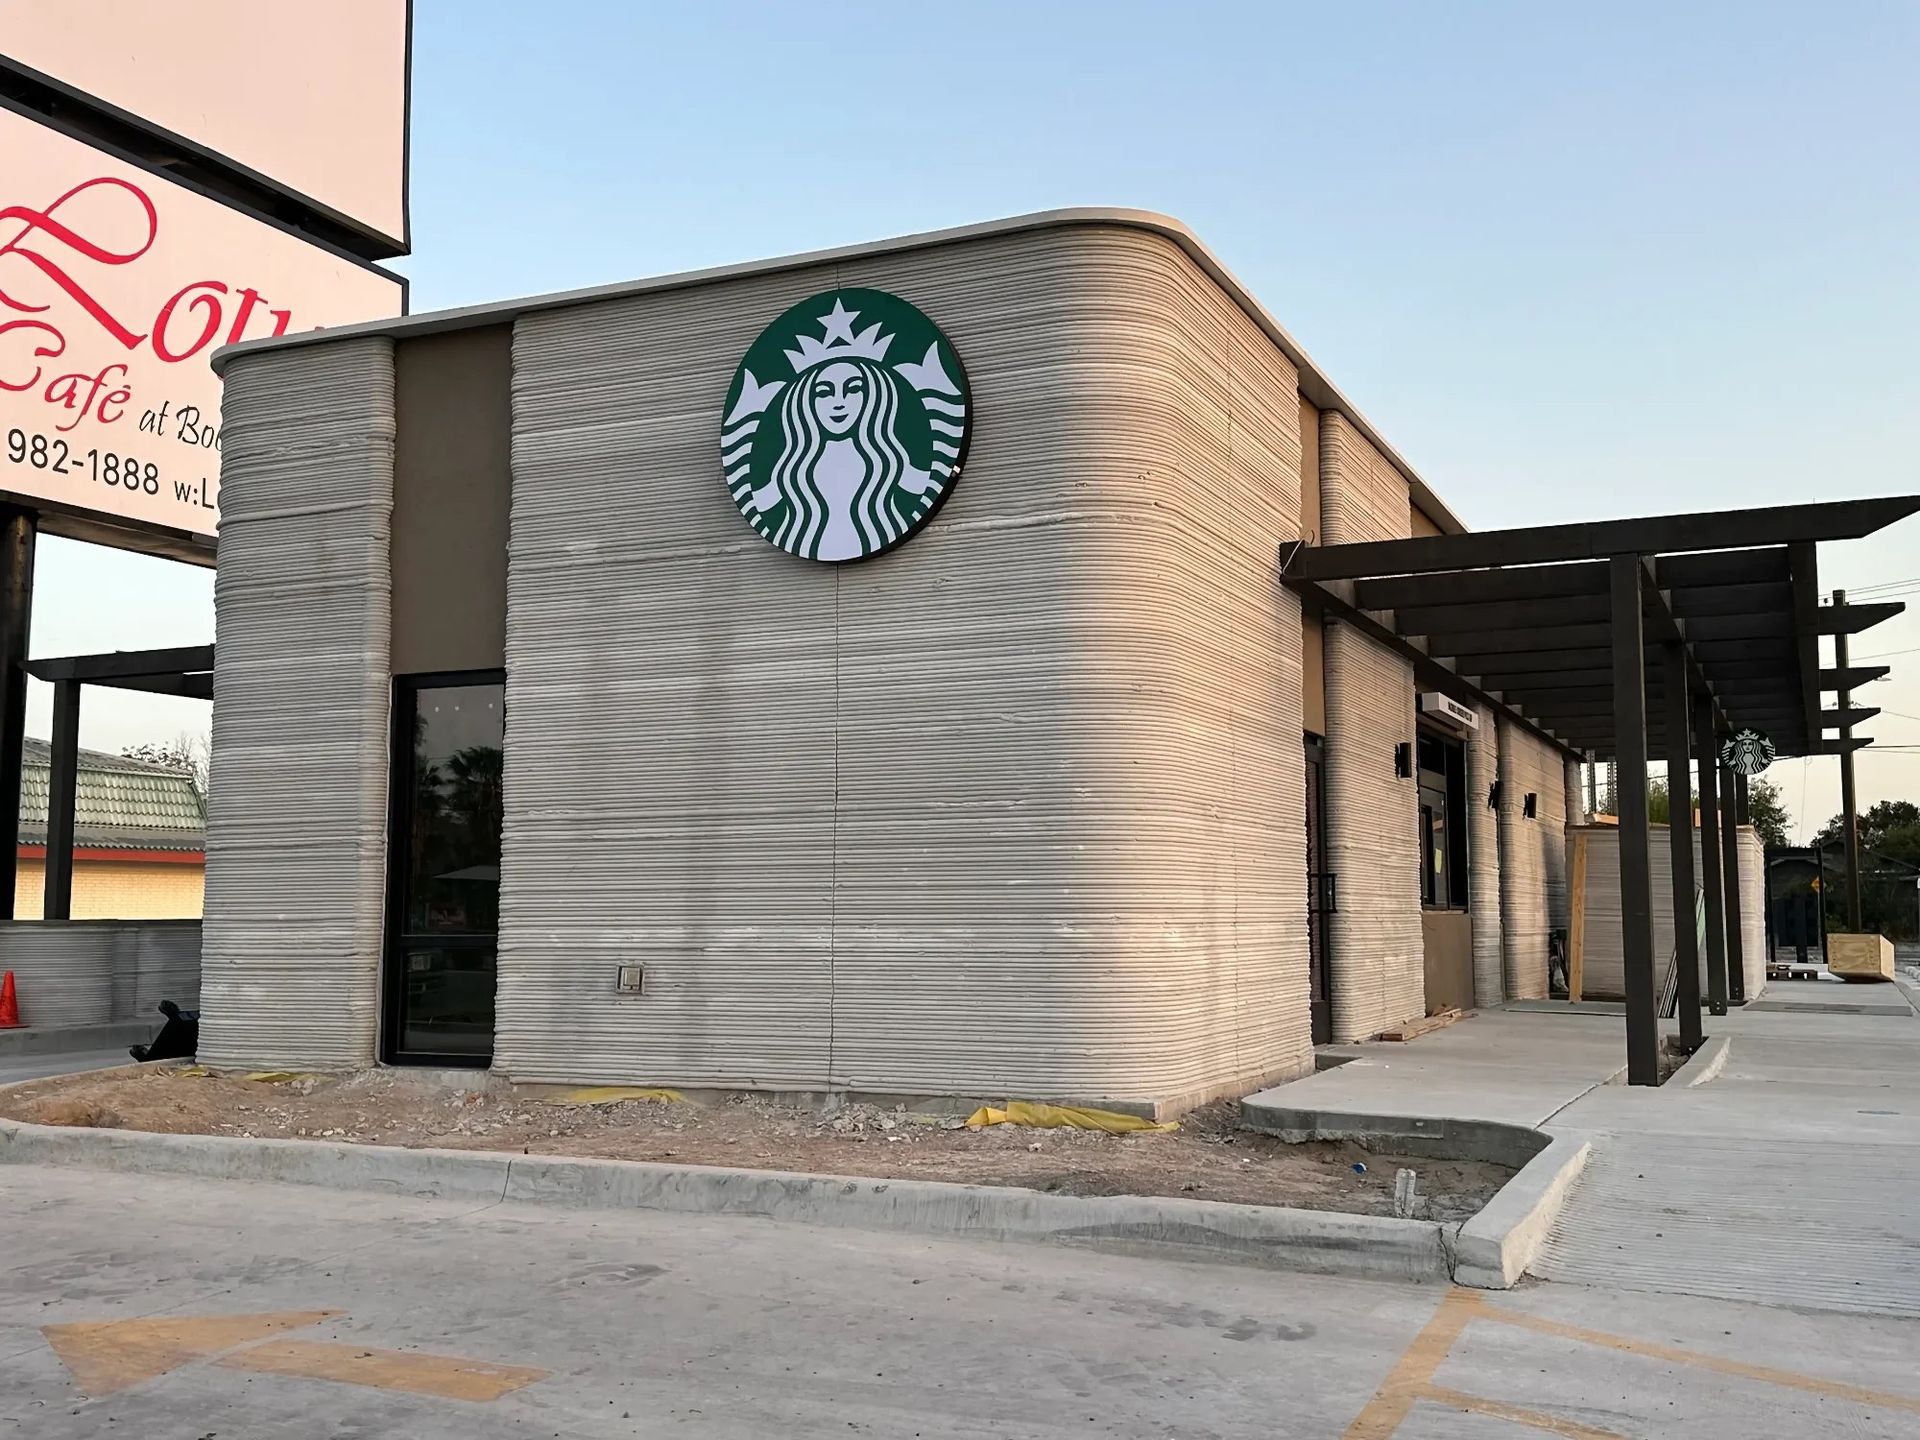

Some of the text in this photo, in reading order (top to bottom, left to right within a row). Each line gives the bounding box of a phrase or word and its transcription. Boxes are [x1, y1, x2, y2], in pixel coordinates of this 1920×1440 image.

[138, 400, 169, 436] at
[8, 428, 217, 509] 982-1888 w:L
